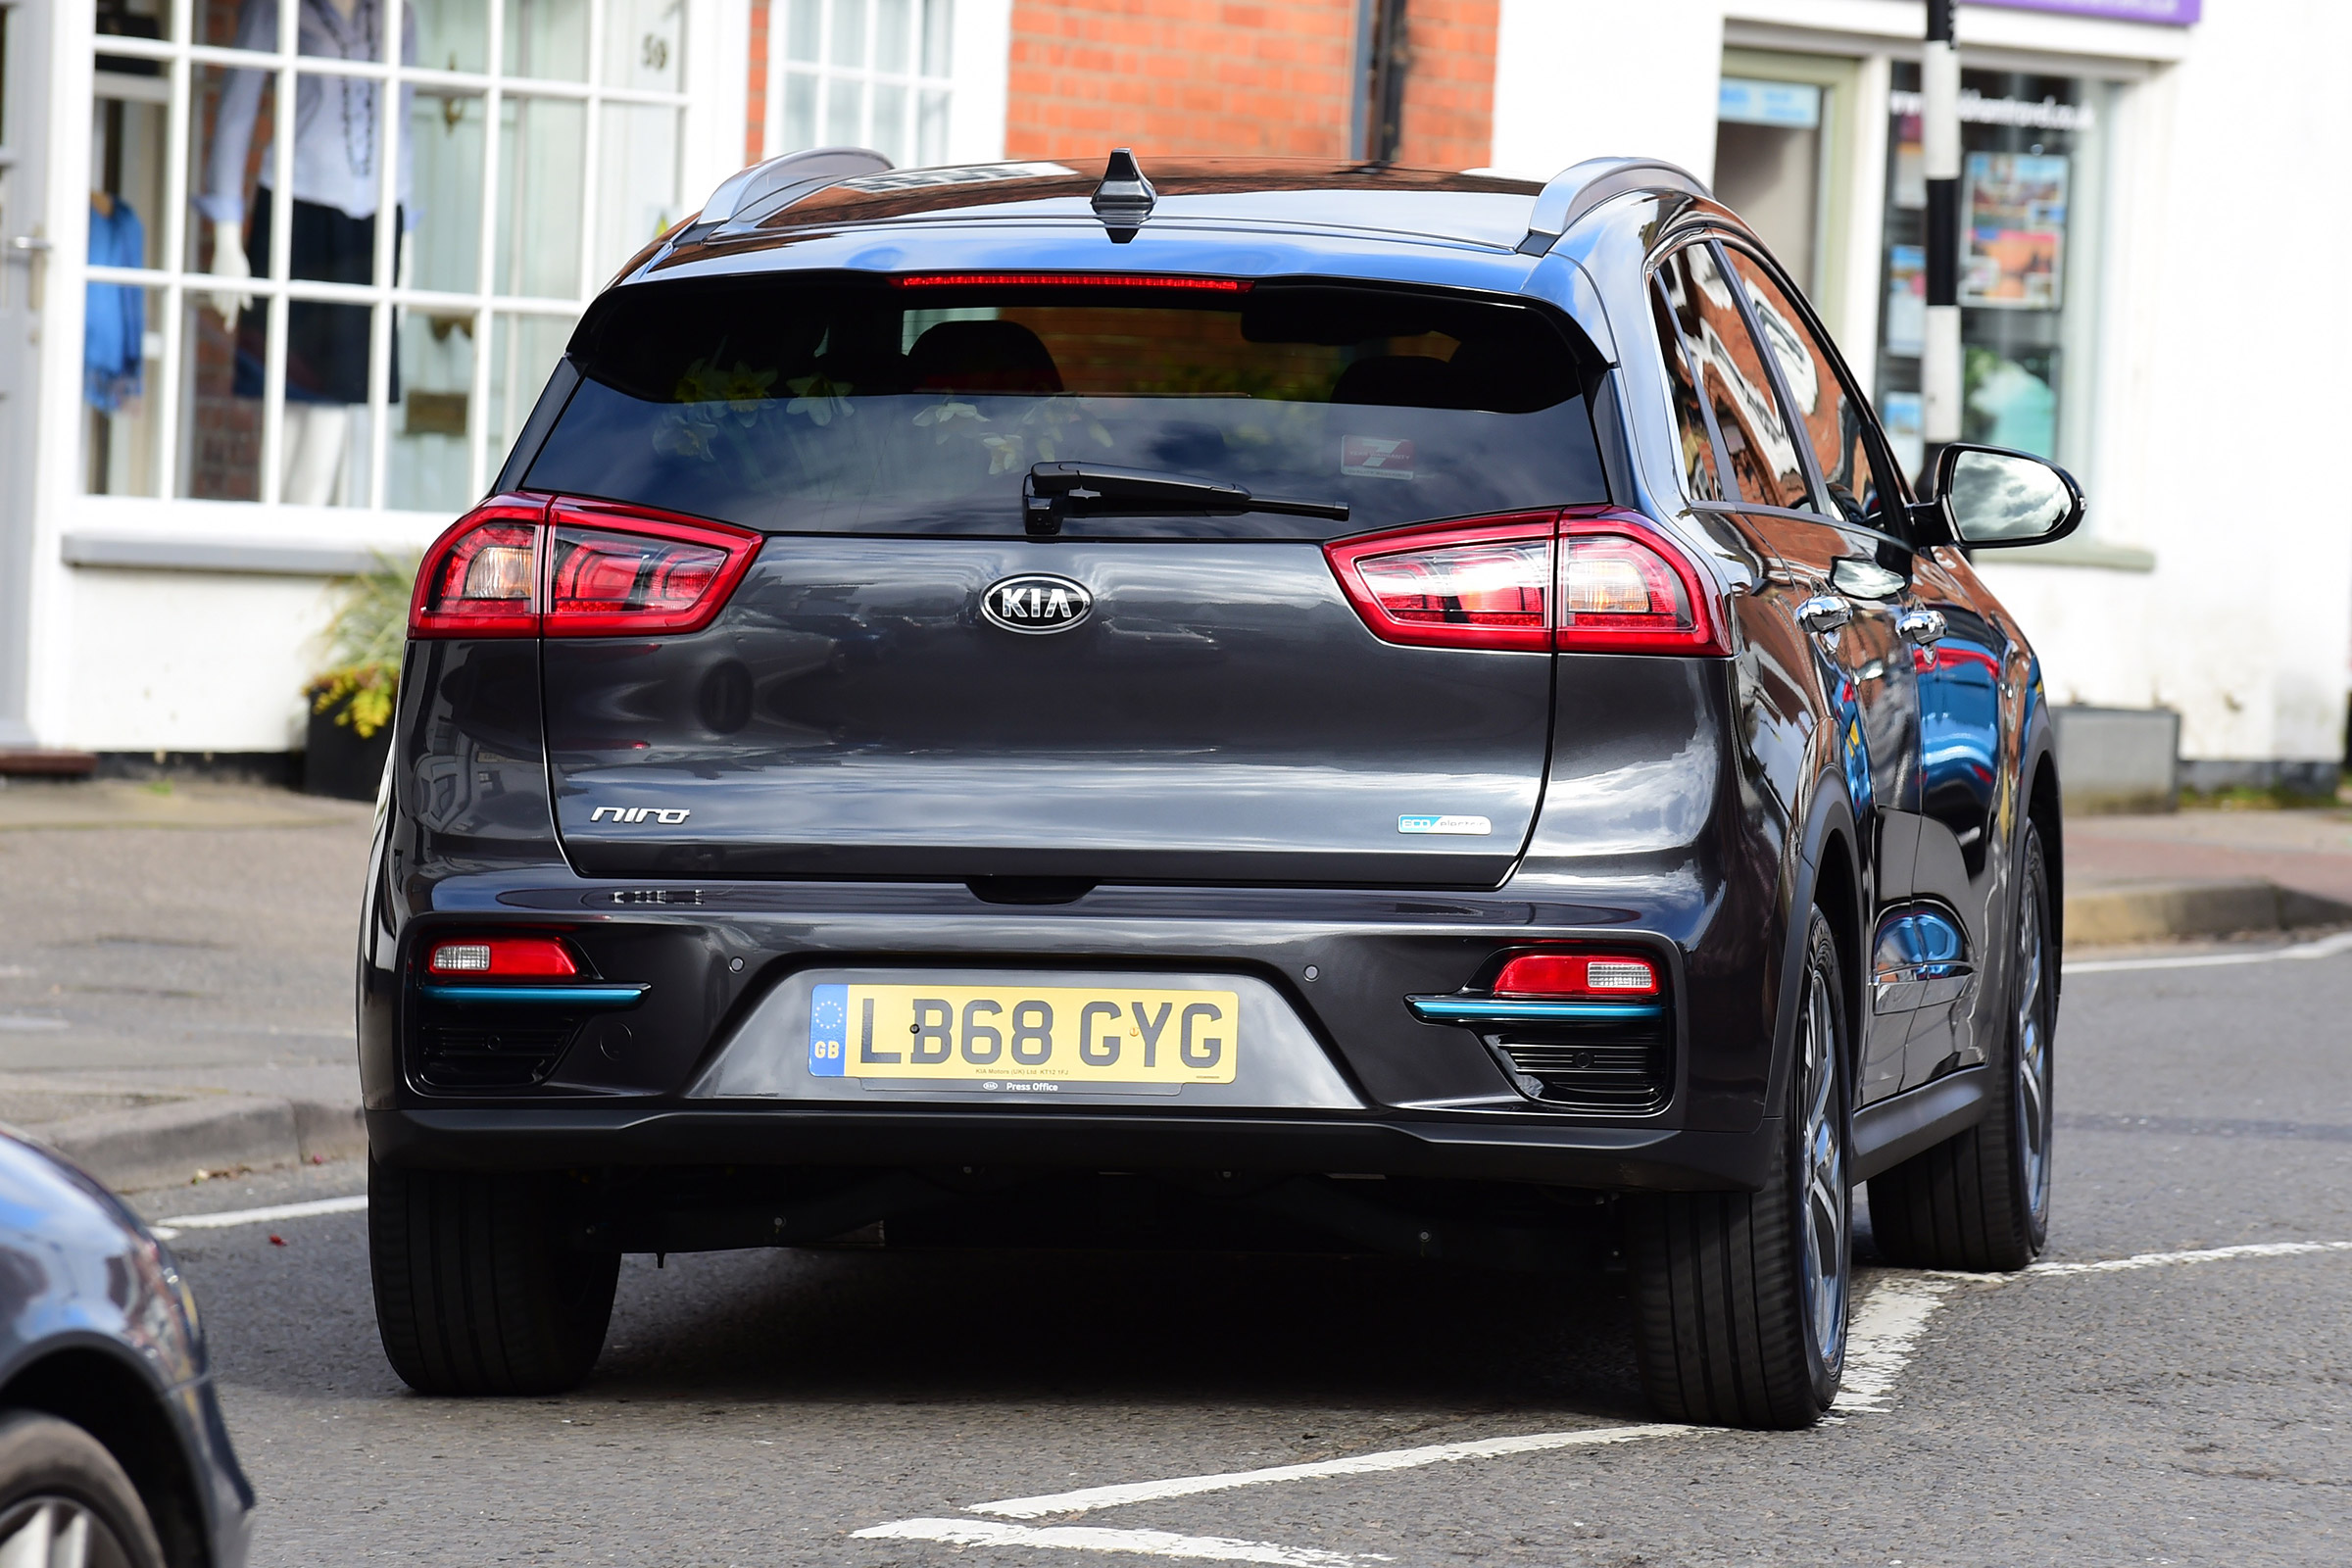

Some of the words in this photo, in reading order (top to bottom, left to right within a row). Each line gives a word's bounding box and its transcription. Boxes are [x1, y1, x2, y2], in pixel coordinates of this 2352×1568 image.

[1002, 588, 1072, 617] KIA
[860, 998, 1054, 1066] LB68
[1079, 1001, 1223, 1069] GYG
[814, 1041, 840, 1059] GB
[1005, 1082, 1031, 1091] Press
[1032, 1083, 1058, 1092] Office
